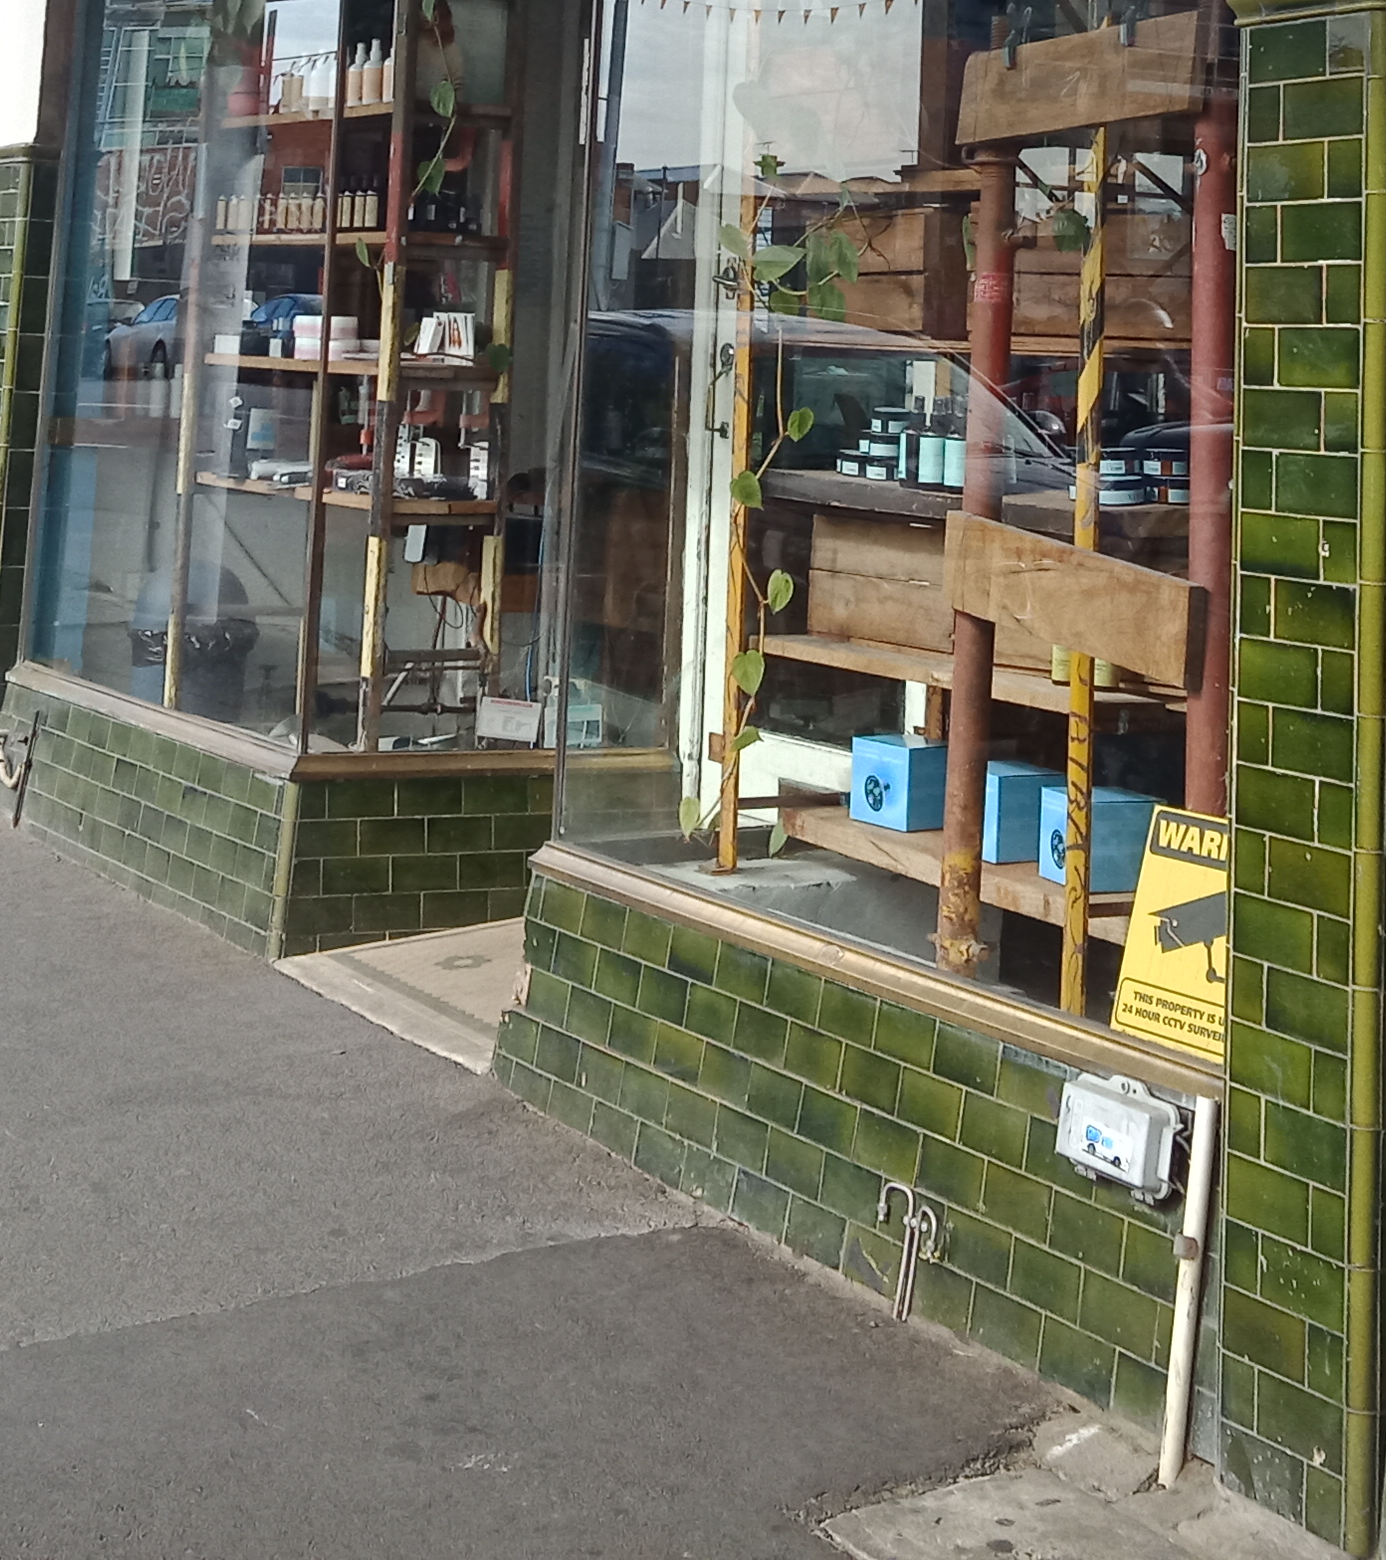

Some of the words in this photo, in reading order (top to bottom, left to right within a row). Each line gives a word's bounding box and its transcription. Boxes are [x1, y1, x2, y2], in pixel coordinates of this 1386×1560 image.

[1121, 1002, 1133, 1014] 24
[1134, 1007, 1161, 1023] HOUR
[1162, 1015, 1187, 1031] CCTV
[1133, 990, 1155, 1006] THIS
[1155, 997, 1206, 1021] PROPERTY
[1206, 1013, 1217, 1025] IS
